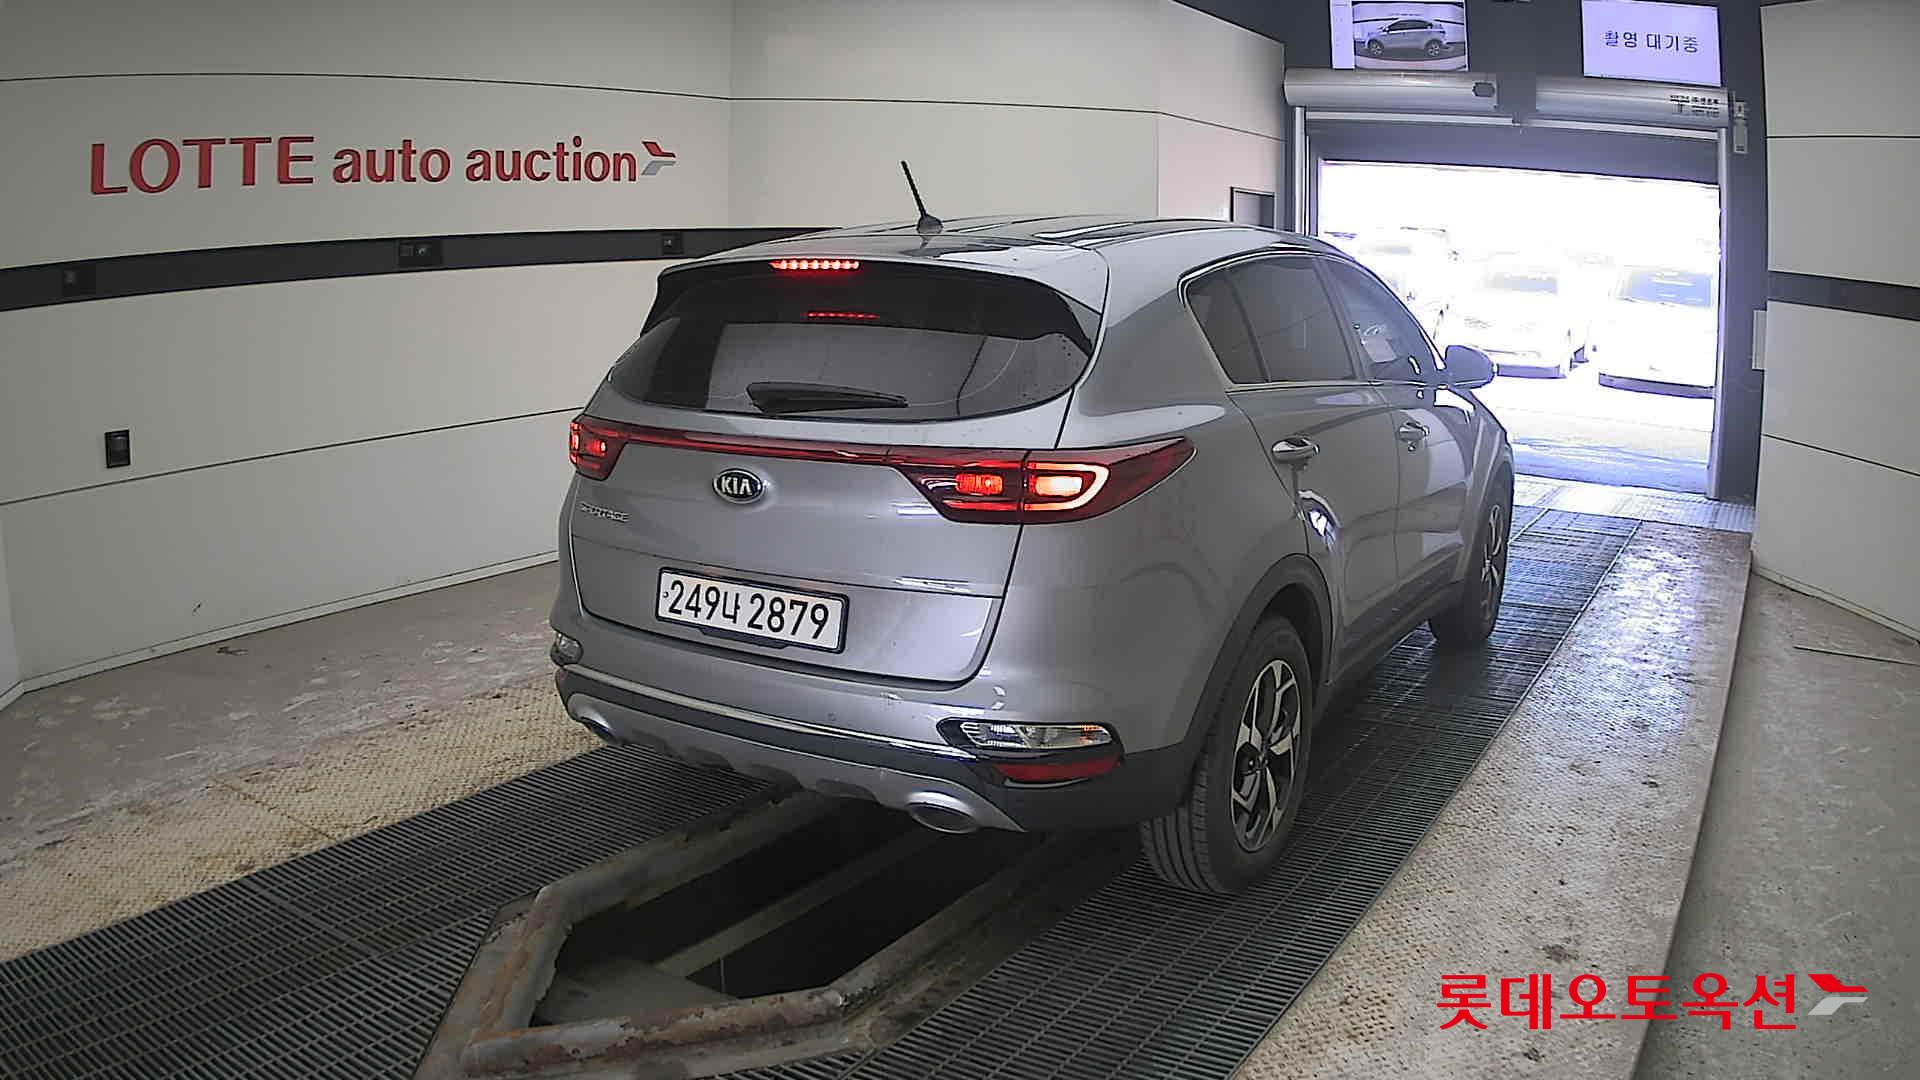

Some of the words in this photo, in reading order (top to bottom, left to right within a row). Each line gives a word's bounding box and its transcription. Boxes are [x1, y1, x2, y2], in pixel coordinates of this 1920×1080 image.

[1603, 30, 1638, 48] 촬영
[1646, 33, 1698, 53] 대기중
[89, 136, 315, 195] LOTTE
[332, 138, 452, 184] auto
[465, 135, 638, 183] auction
[721, 475, 753, 496] KIA
[668, 580, 740, 624] 249나
[747, 592, 829, 639] 2879
